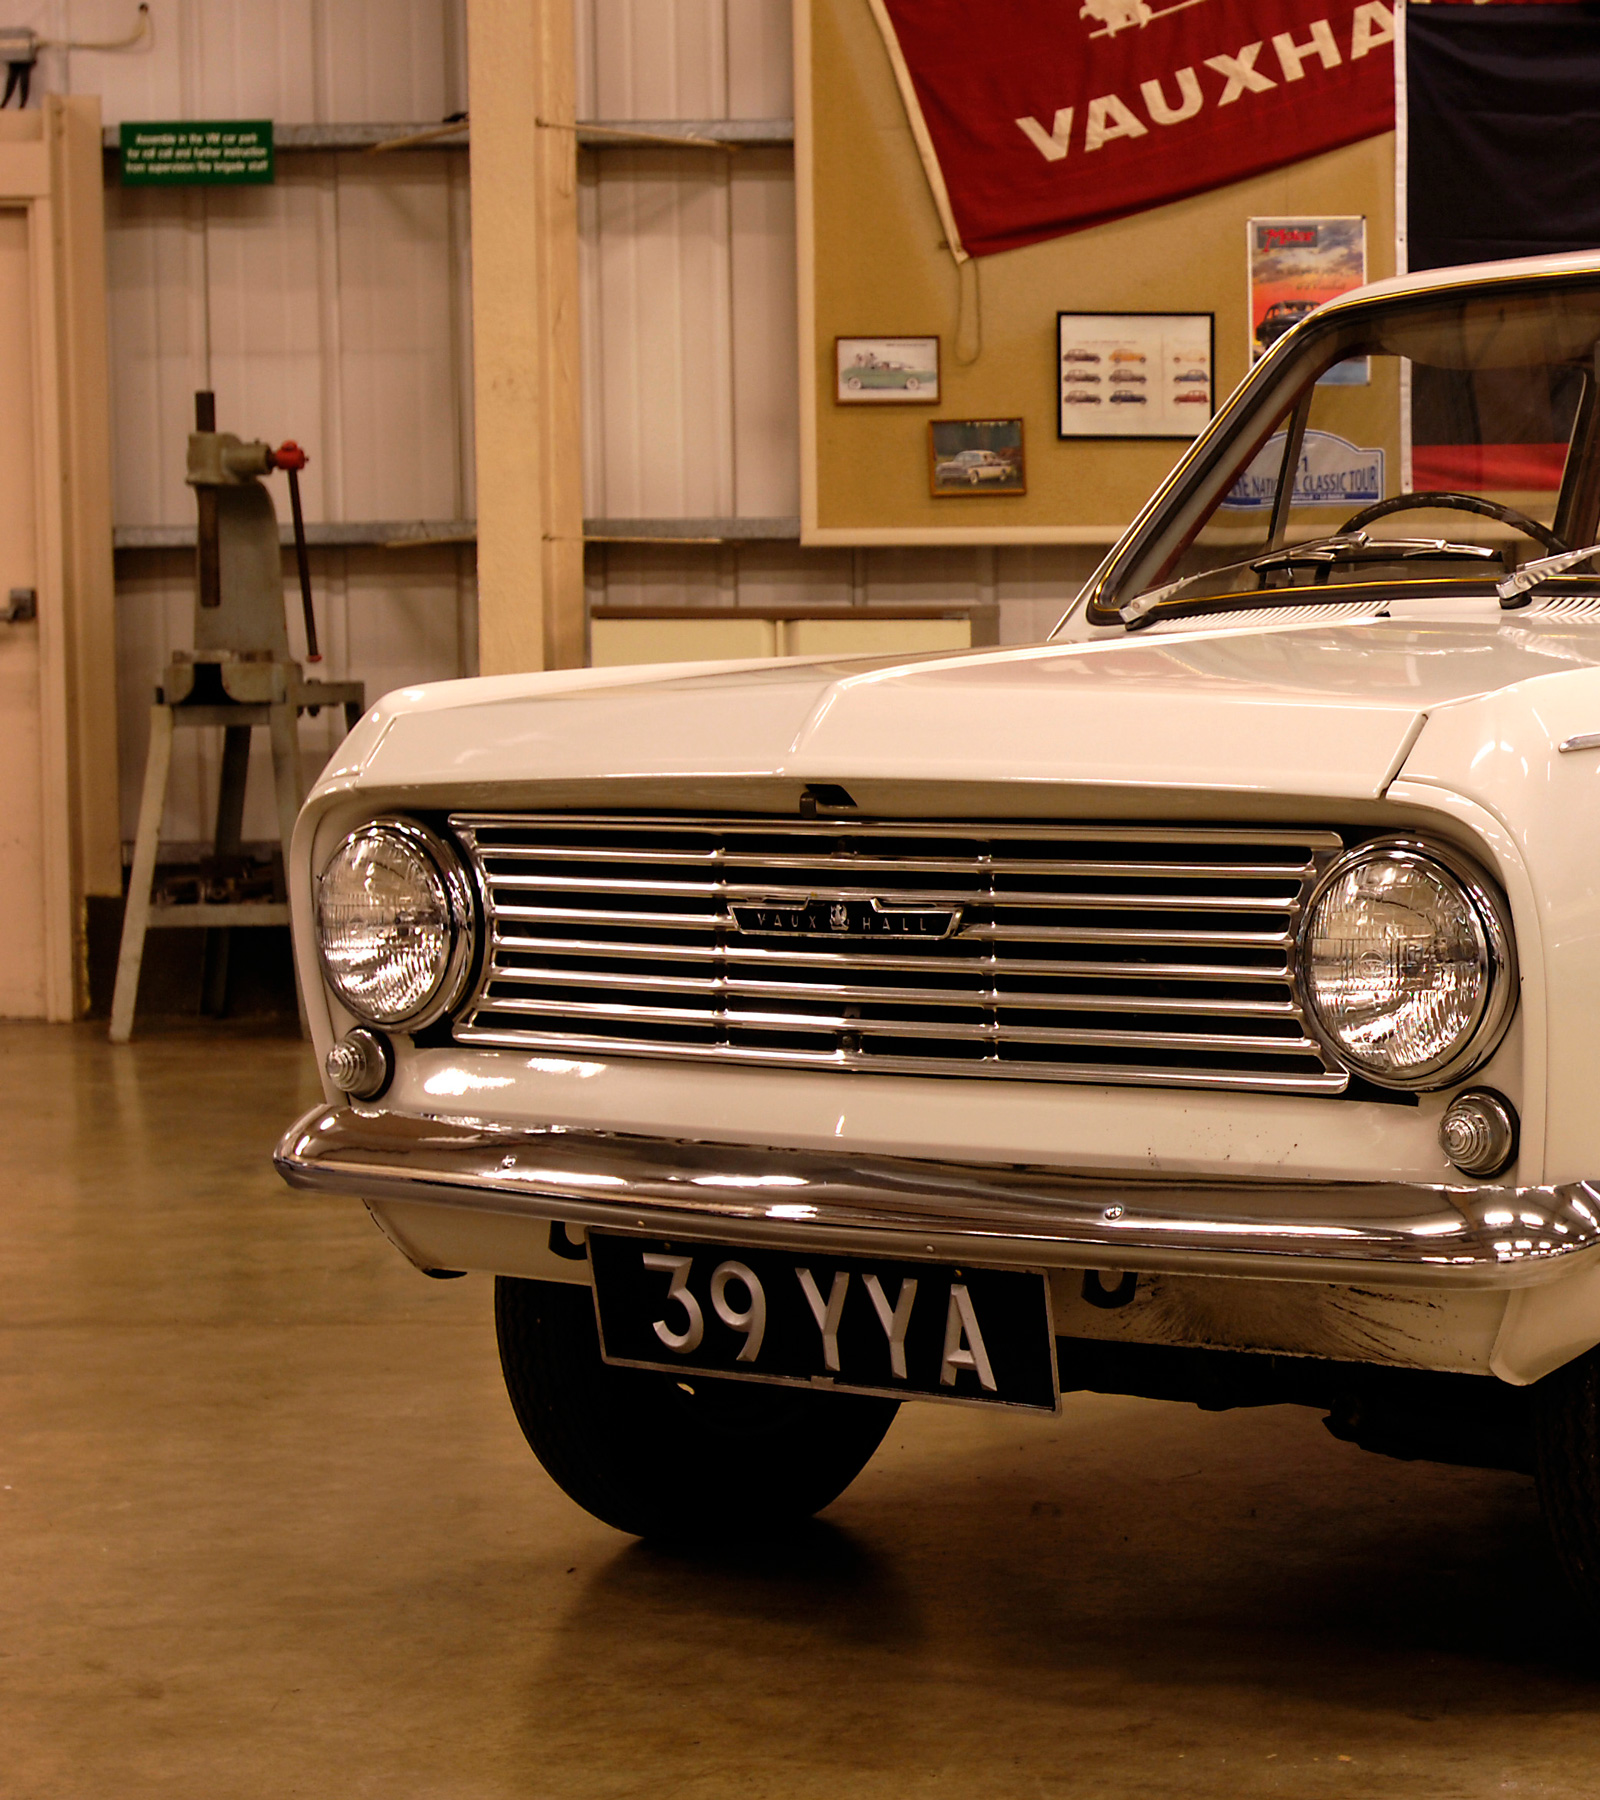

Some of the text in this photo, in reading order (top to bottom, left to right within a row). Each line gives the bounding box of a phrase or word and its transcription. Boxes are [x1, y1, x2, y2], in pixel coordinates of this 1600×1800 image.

[1014, 0, 1394, 162] VAUXHA
[188, 133, 203, 145] the
[222, 134, 236, 145] car
[174, 147, 191, 159] and
[1303, 473, 1347, 492] CLASSIC
[757, 912, 927, 932] VAUX HALL
[642, 1252, 998, 1393] 39 YYA
